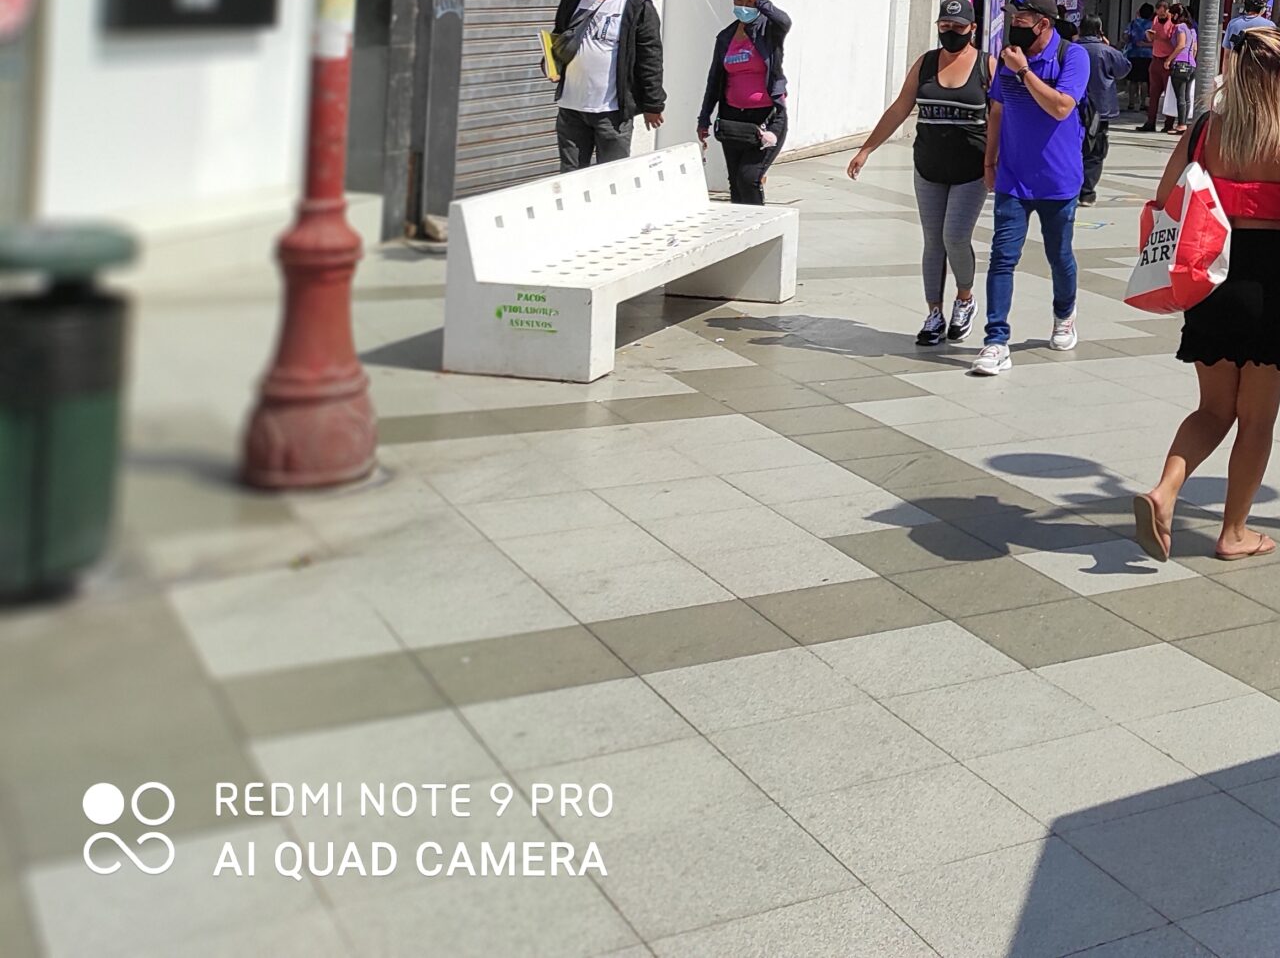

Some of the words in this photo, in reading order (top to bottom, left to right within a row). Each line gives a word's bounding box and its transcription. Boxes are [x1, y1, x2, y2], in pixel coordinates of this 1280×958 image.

[919, 105, 975, 119] EVERLA
[1147, 228, 1180, 246] UEN
[517, 293, 546, 302] PACOS
[510, 319, 552, 328] ASESINOS
